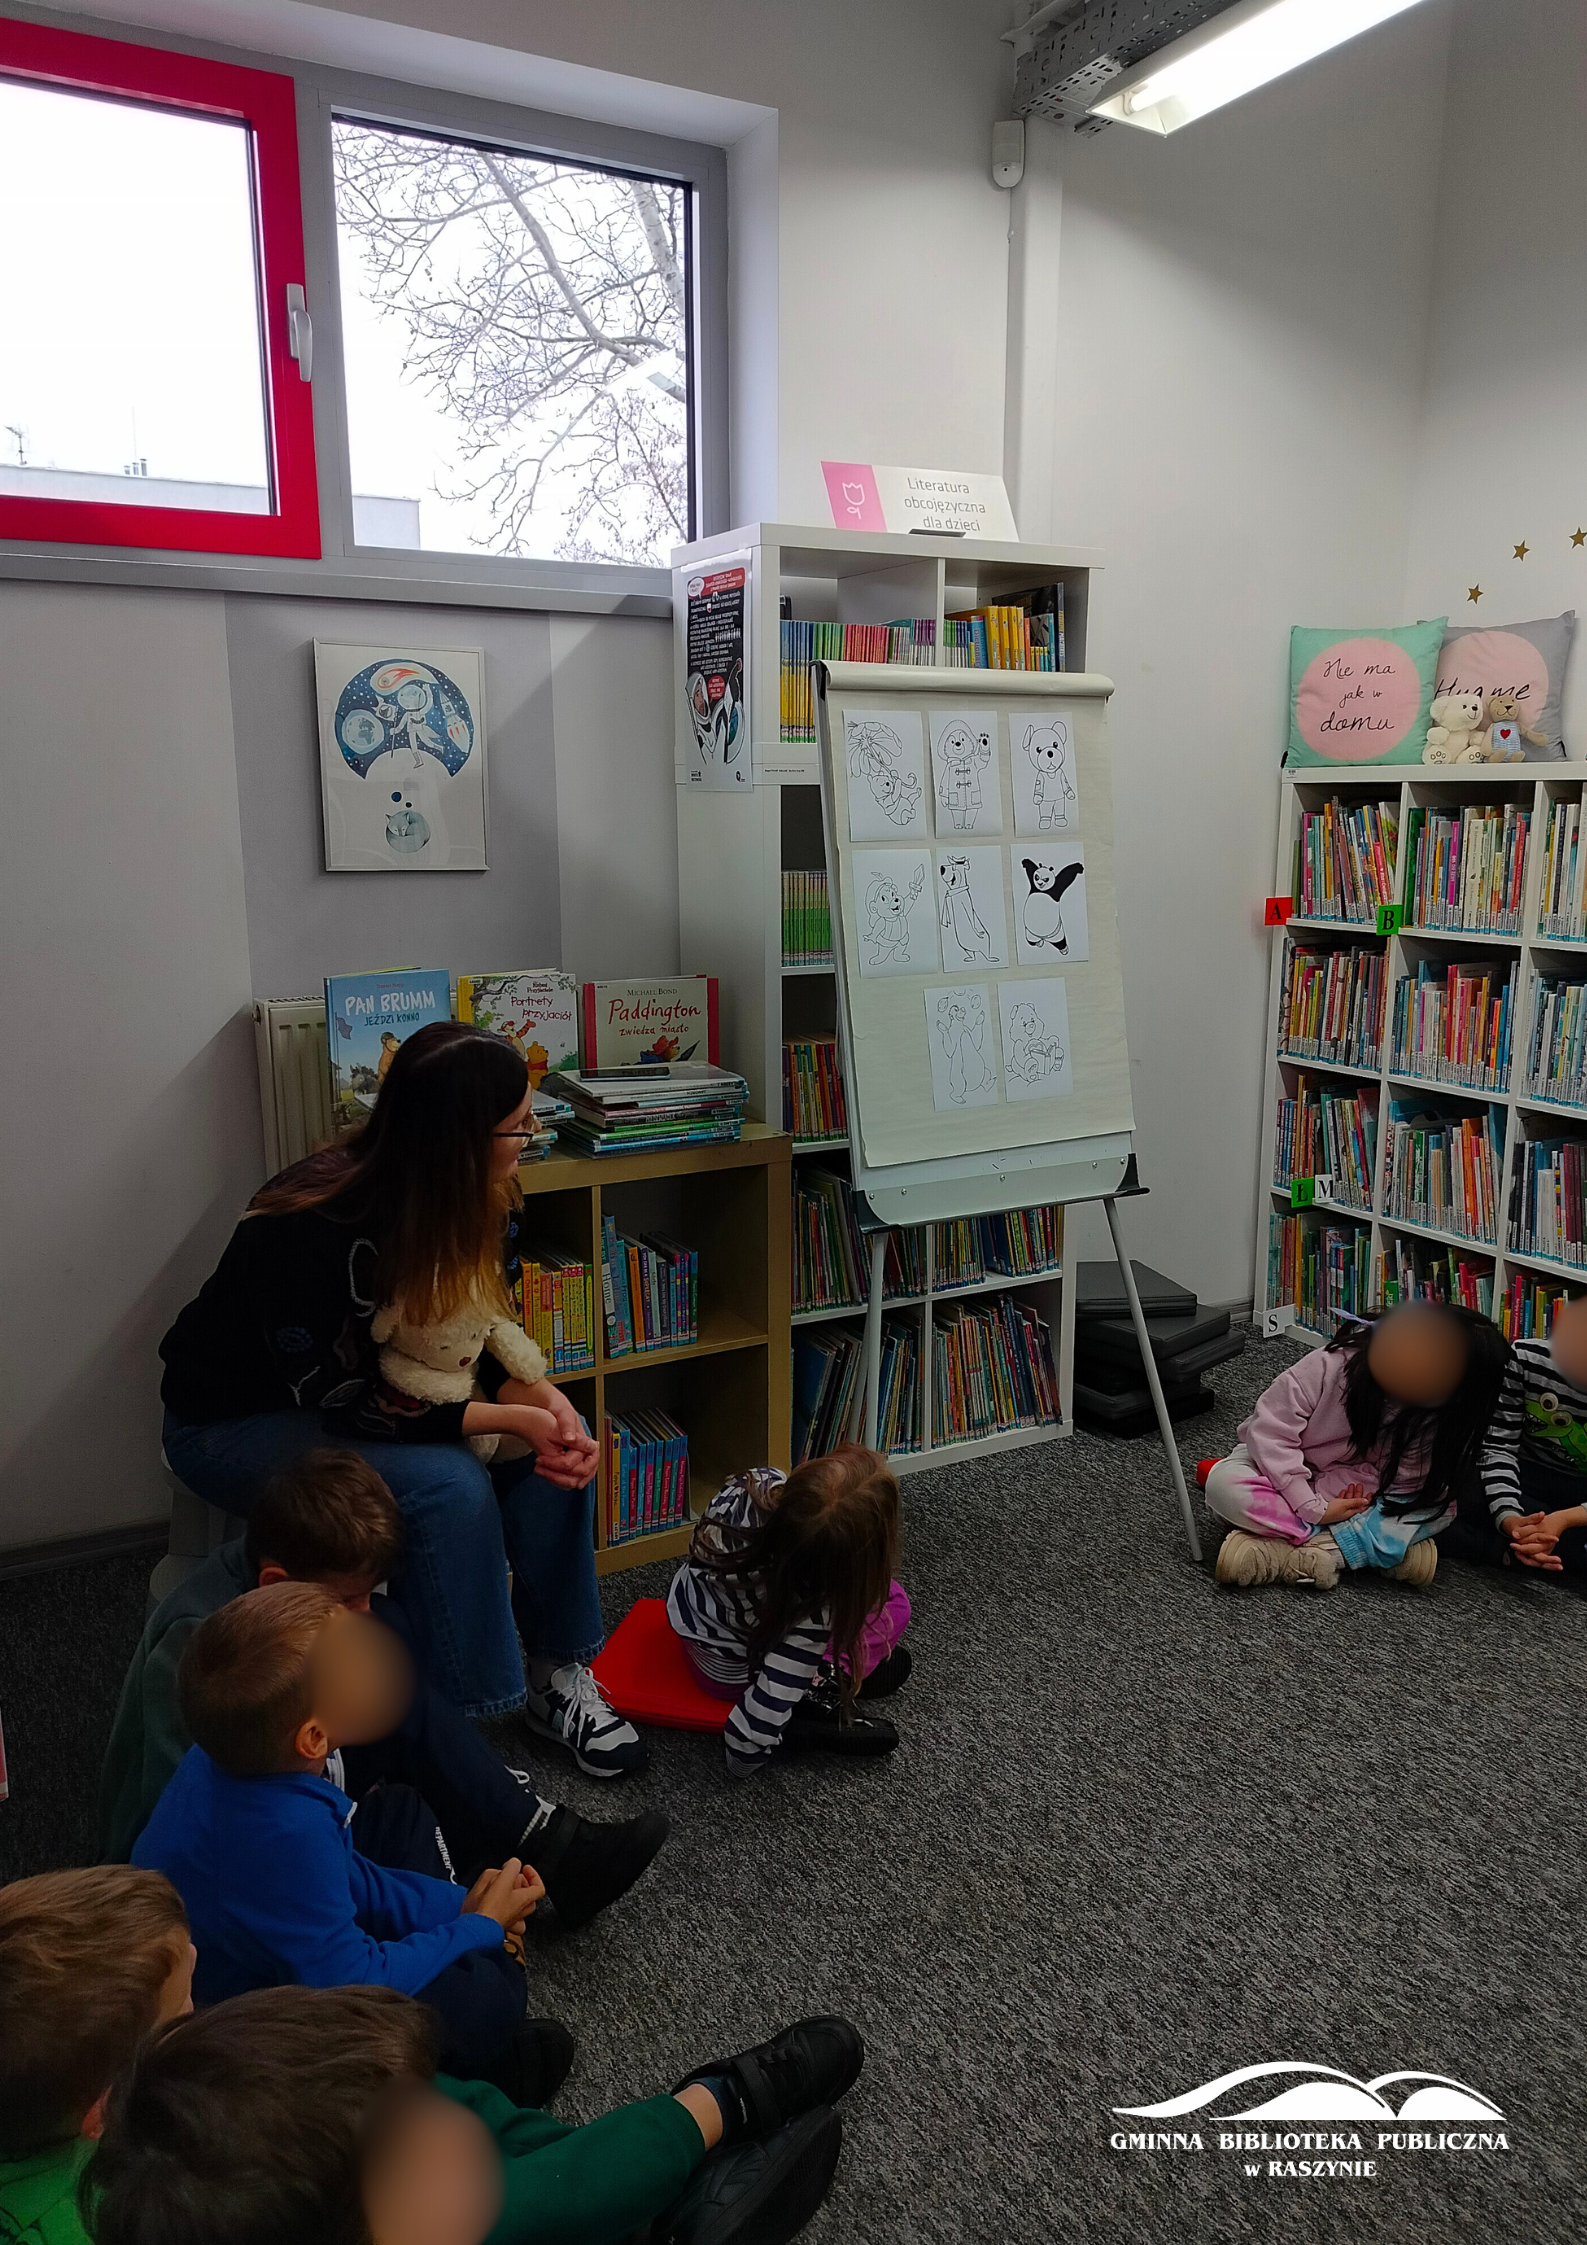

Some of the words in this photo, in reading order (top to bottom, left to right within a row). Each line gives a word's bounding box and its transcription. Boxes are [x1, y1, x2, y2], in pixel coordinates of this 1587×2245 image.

[907, 478, 970, 494] Literatura
[904, 497, 986, 514] obcojęzyczna
[923, 516, 943, 529] dla
[945, 517, 981, 531] dzieci
[1323, 658, 1354, 679] Nie
[1364, 664, 1396, 675] ma
[1338, 685, 1364, 708] jak
[1373, 690, 1383, 699] w
[1320, 711, 1395, 732] domu
[1269, 902, 1282, 920] A
[1382, 910, 1395, 931] B
[345, 995, 375, 1016] PAN
[381, 990, 436, 1013] BRUMM
[511, 996, 554, 1007] Portrety
[364, 1012, 394, 1027] JEŹDZI
[396, 1012, 420, 1023] KONNO
[522, 1008, 573, 1021] przyjaciół
[608, 999, 701, 1026] Paddington
[620, 1026, 655, 1036] zwiedza
[660, 1023, 689, 1033] miasto
[1296, 1183, 1308, 1202] Ł
[1318, 1180, 1334, 1198] M
[602, 1273, 612, 1304] Home
[1268, 1314, 1278, 1332] S
